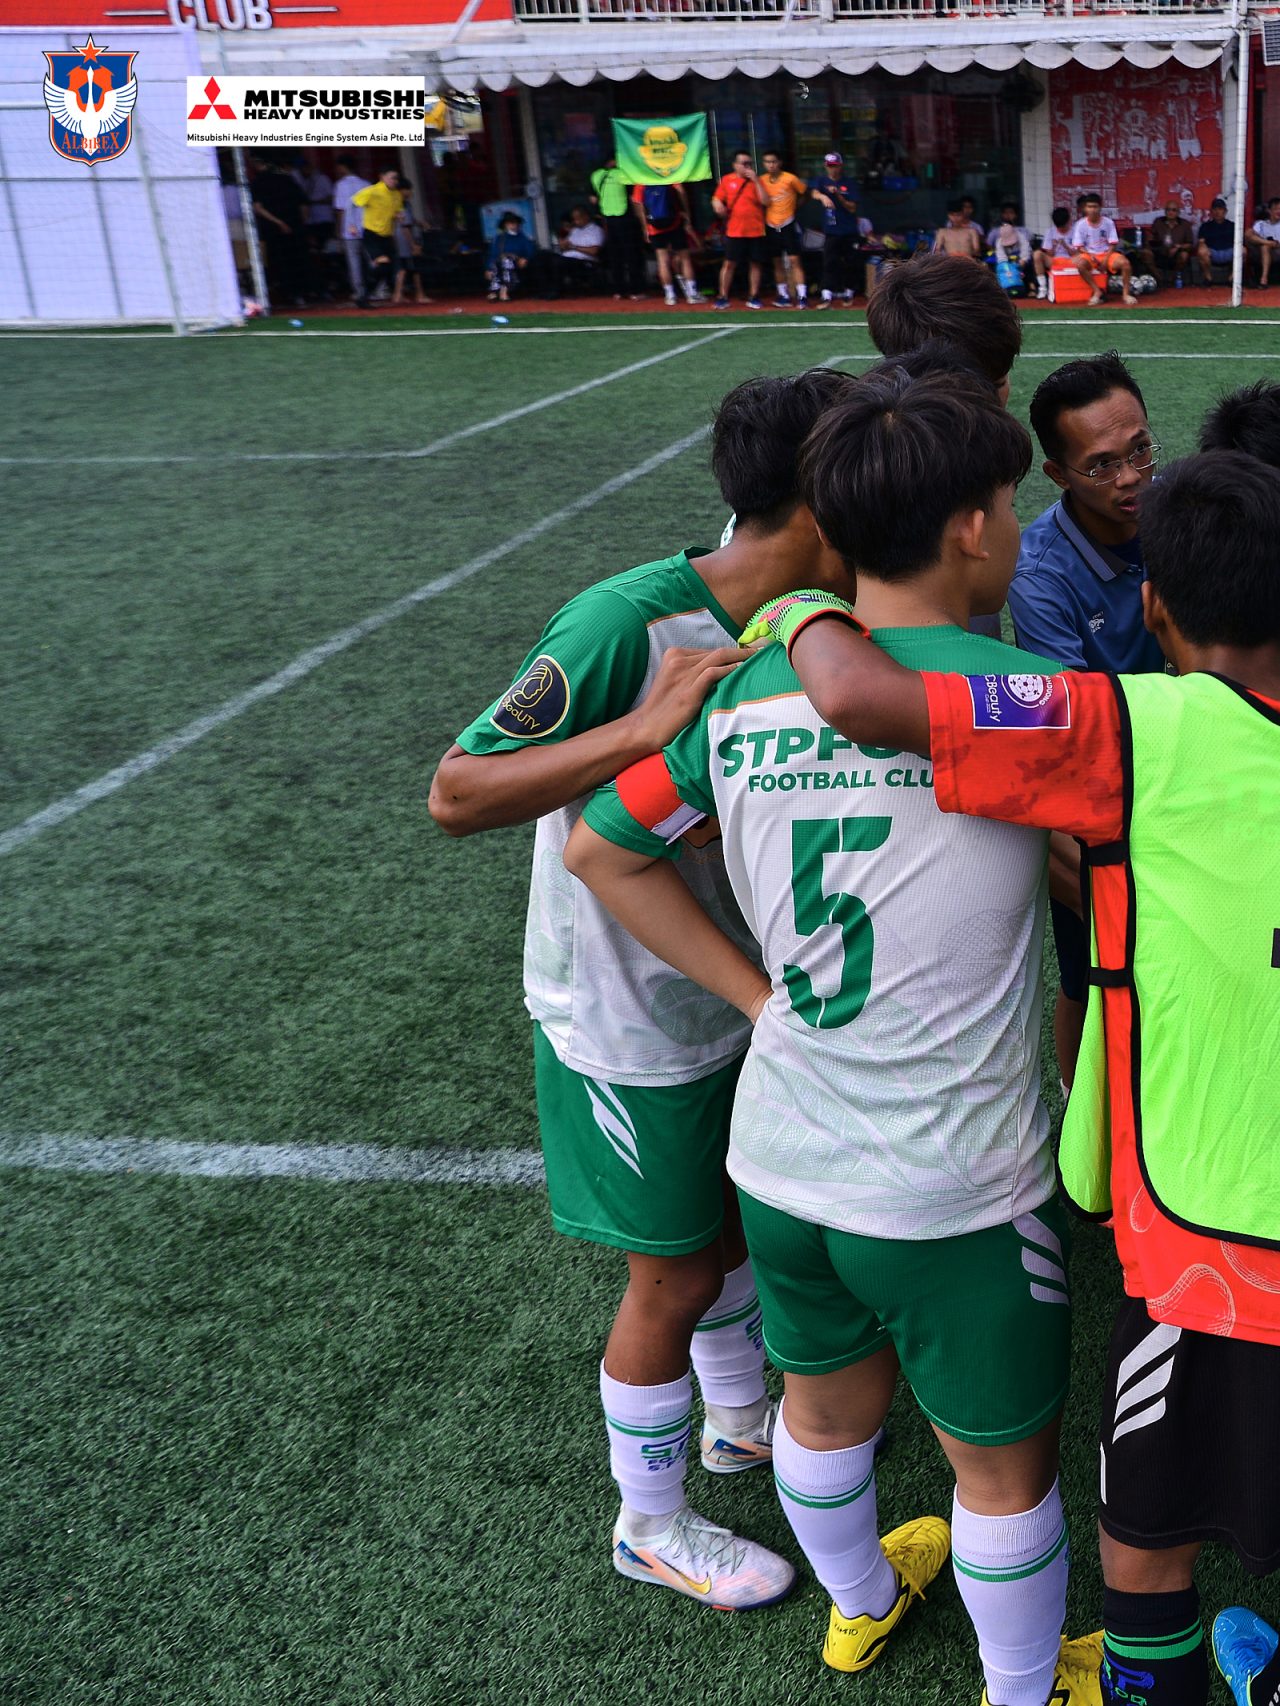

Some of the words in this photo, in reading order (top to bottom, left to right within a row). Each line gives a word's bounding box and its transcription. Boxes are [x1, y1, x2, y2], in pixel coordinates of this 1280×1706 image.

[167, 0, 272, 31] CLUB
[749, 770, 876, 792] FOOTBALL
[884, 768, 934, 788] CLU
[782, 816, 893, 1030] 5
